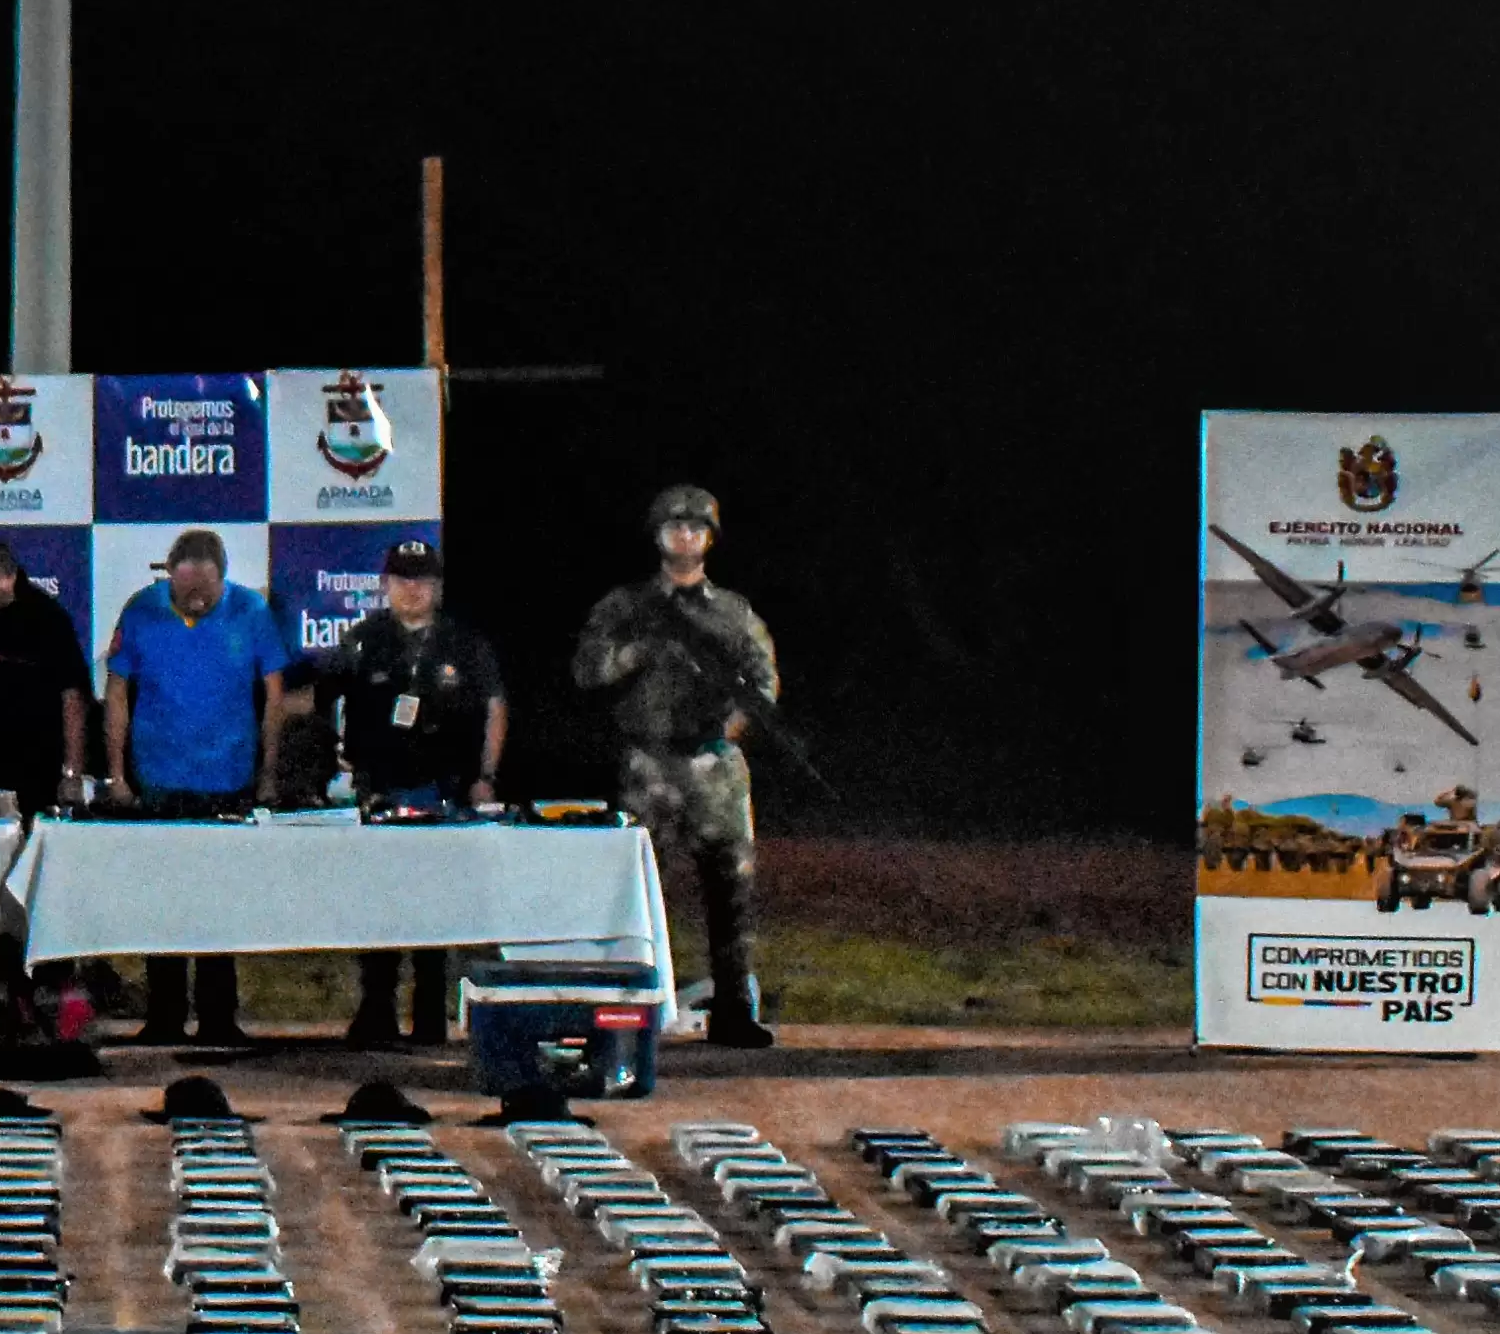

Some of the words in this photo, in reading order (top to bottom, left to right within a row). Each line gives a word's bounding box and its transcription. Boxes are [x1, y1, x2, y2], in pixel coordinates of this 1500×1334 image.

[126, 435, 235, 475] bandera
[1366, 521, 1464, 536] NACIONAL
[1261, 946, 1465, 968] COMPROMETIDOS
[1261, 971, 1306, 991] CON
[1312, 969, 1465, 994] NUESTRO
[1381, 994, 1455, 1023] PAÍS
